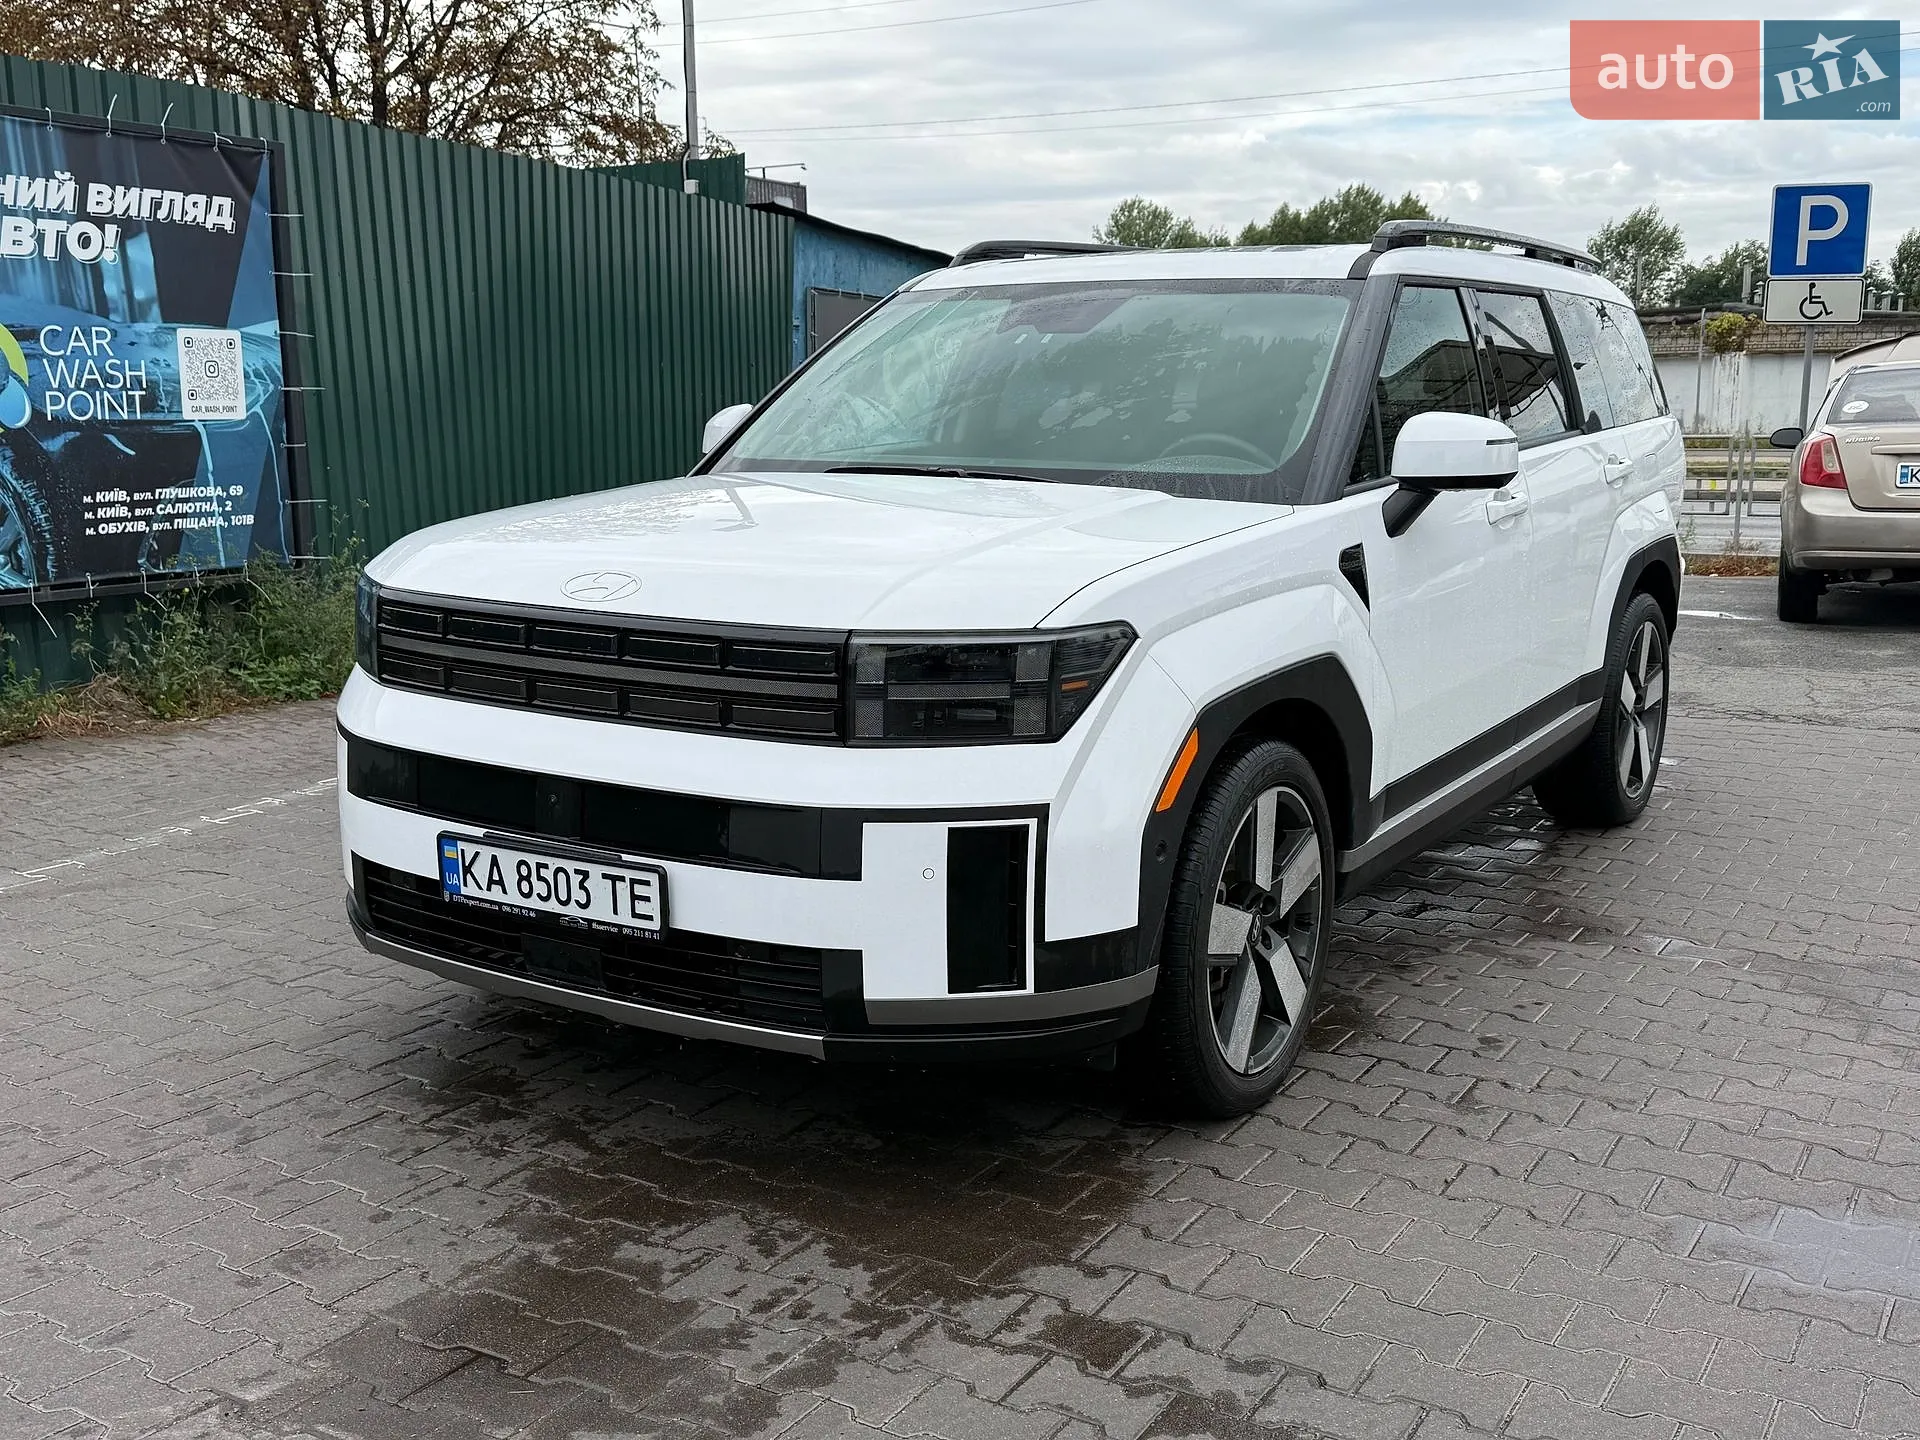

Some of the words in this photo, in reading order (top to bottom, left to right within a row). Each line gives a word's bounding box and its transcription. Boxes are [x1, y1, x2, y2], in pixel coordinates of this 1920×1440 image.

[86, 182, 236, 234] ВИГЛЯД
[1795, 195, 1849, 266] P
[39, 325, 114, 356] CAR
[42, 359, 147, 389] WASH
[45, 390, 146, 421] POINT
[191, 404, 238, 414] CAR_WASH_POINT
[95, 487, 131, 503] КИЇВ,
[155, 486, 227, 500] ГЛУШКОВА,
[229, 485, 244, 497] 69
[97, 503, 132, 519] КИЇВ,
[156, 501, 223, 515] САЛЮТНА,
[224, 500, 233, 512] 2
[98, 520, 150, 535] ОБУХІВ,
[173, 516, 229, 530] ПІЩАНА,
[445, 871, 460, 886] UA
[460, 848, 508, 896] KA
[515, 858, 592, 910] 8503
[601, 872, 654, 922] TE
